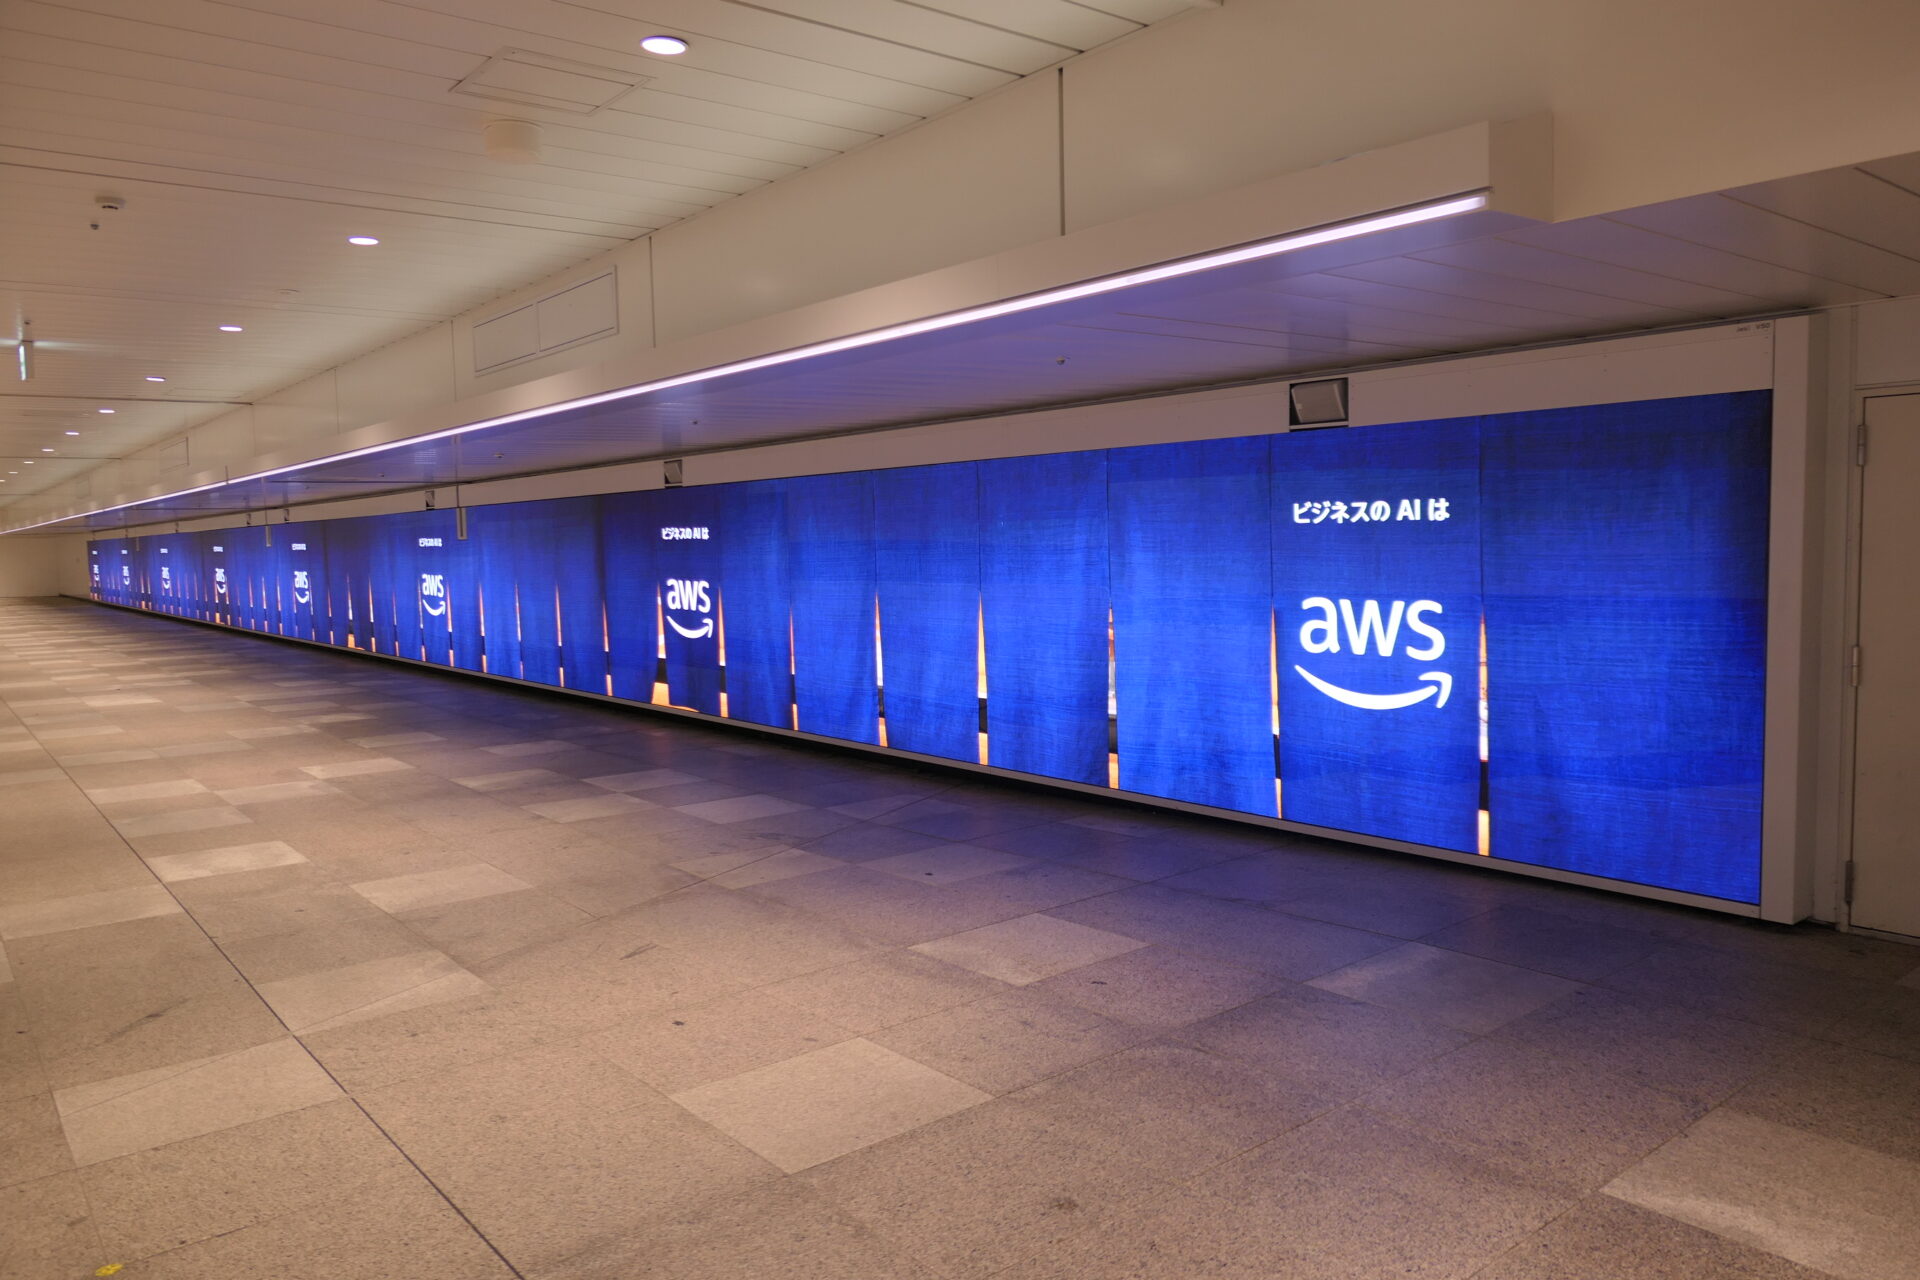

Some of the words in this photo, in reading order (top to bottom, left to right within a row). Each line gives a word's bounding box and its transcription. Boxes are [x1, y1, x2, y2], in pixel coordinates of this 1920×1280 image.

[1292, 501, 1391, 525] ビジネスの
[1395, 498, 1421, 522] AI
[1428, 497, 1451, 522] は
[421, 573, 445, 598] aws
[666, 578, 712, 614] aws
[1299, 596, 1447, 662] aws
